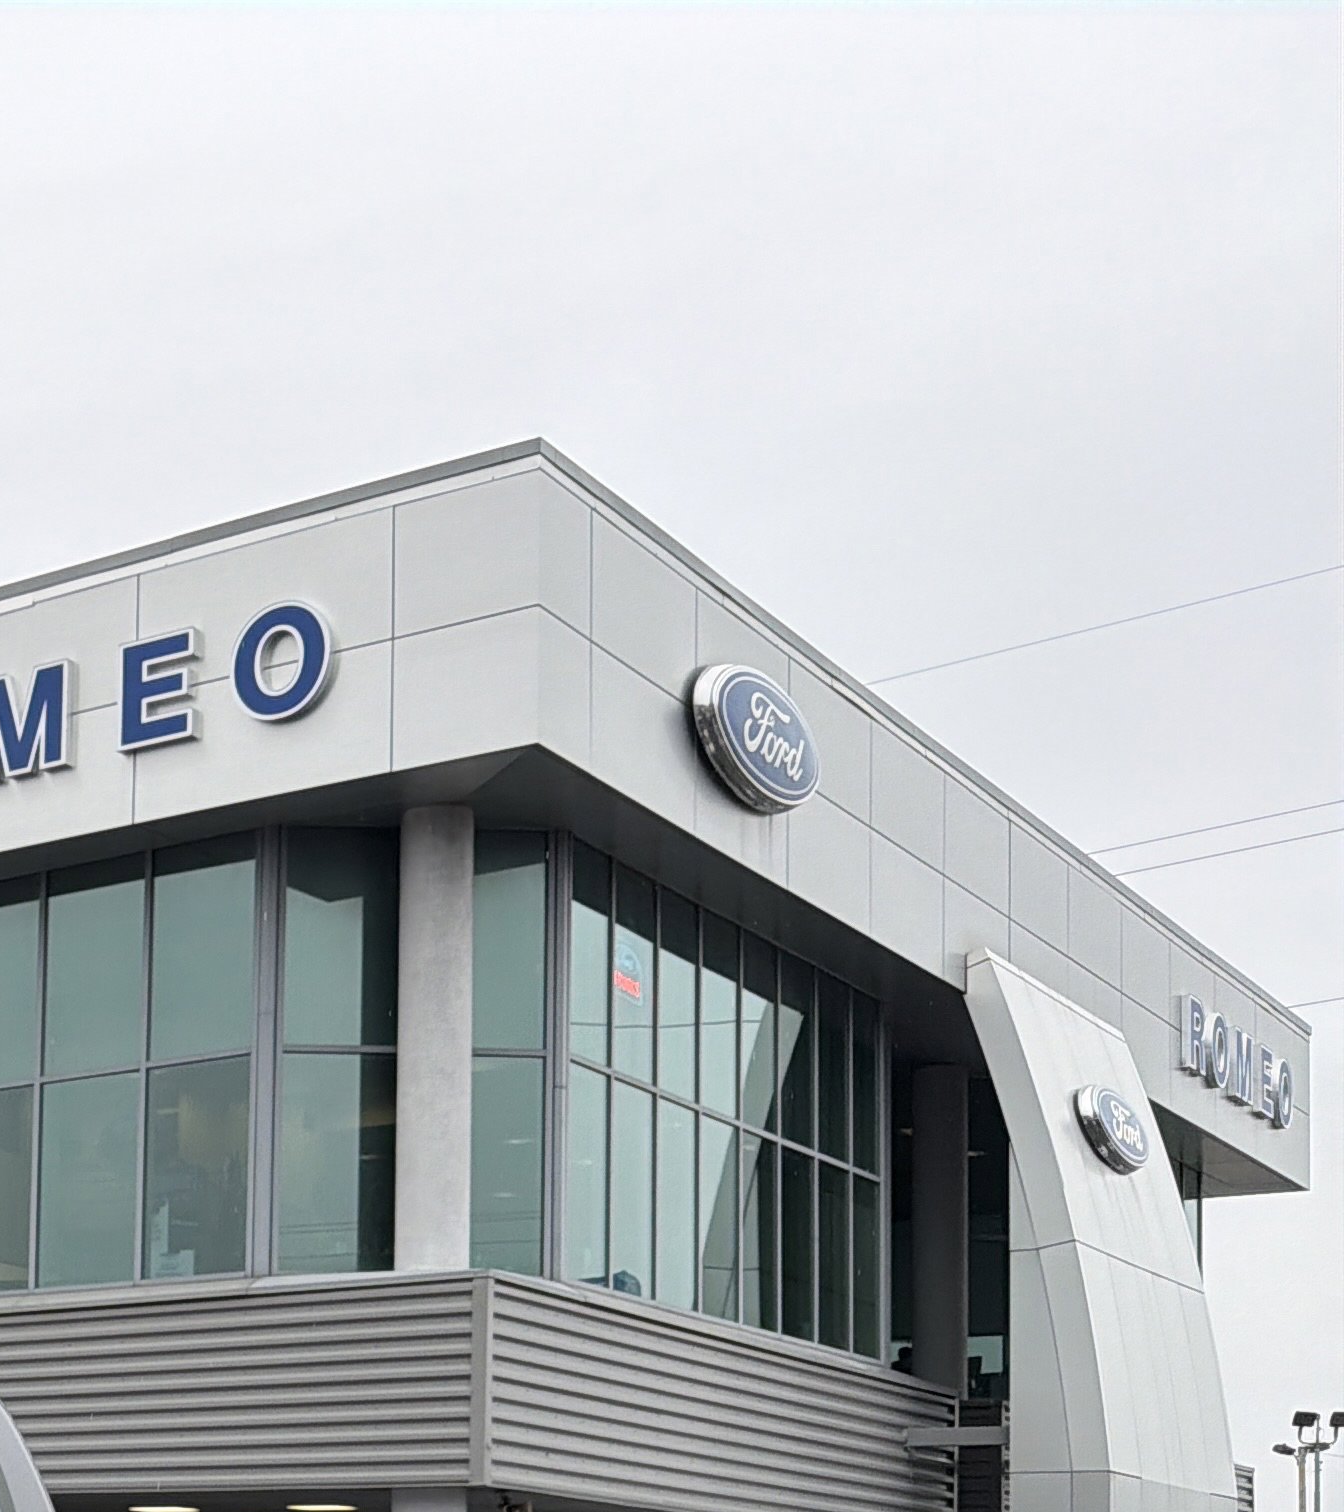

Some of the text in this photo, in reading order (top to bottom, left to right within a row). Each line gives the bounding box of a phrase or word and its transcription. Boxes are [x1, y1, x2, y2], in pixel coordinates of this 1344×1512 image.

[743, 691, 805, 782] Ford
[1183, 994, 1294, 1129] ROMEO
[1110, 1100, 1144, 1152] Ford
